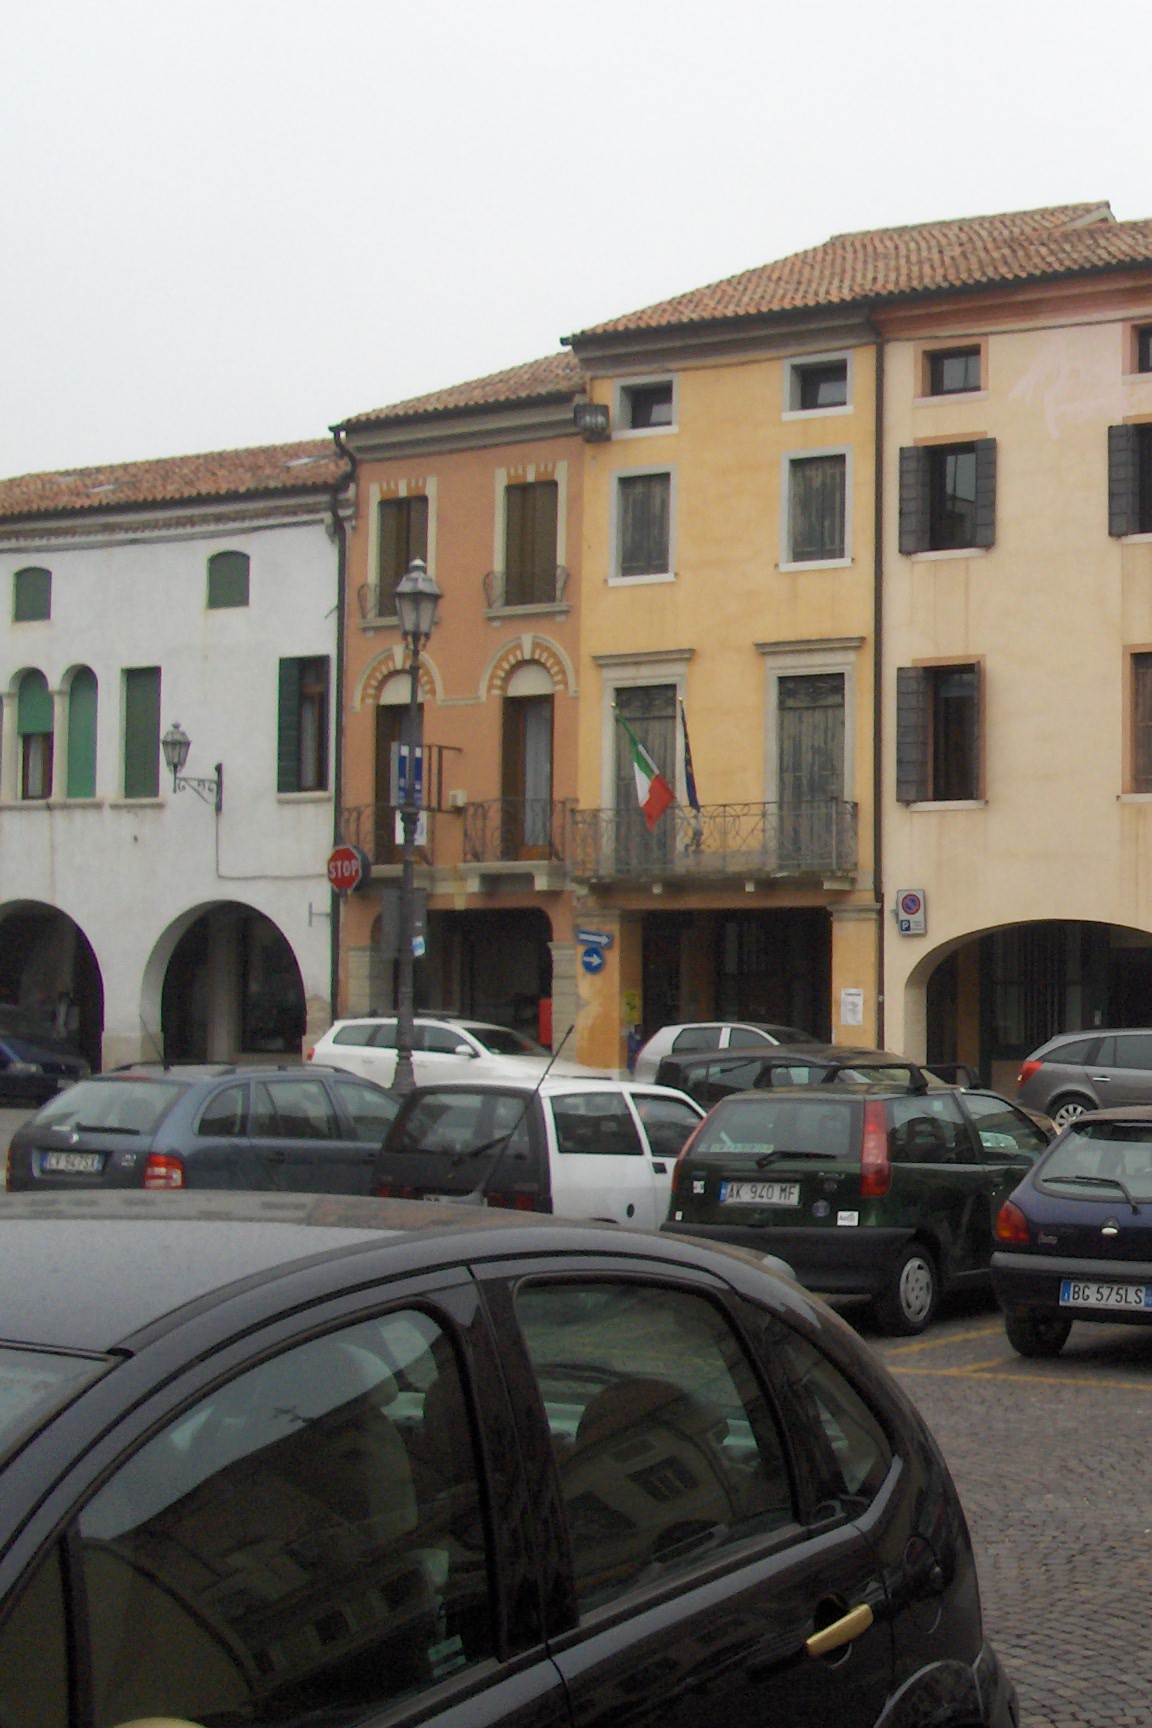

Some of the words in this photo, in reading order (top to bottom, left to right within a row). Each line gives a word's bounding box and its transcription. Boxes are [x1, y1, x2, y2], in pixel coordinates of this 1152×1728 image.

[329, 860, 358, 878] STOP
[728, 1184, 742, 1200] AK
[750, 1186, 775, 1201] 940
[778, 1185, 797, 1201] MF
[1072, 1284, 1091, 1301] BG
[1095, 1285, 1143, 1305] 575LS
